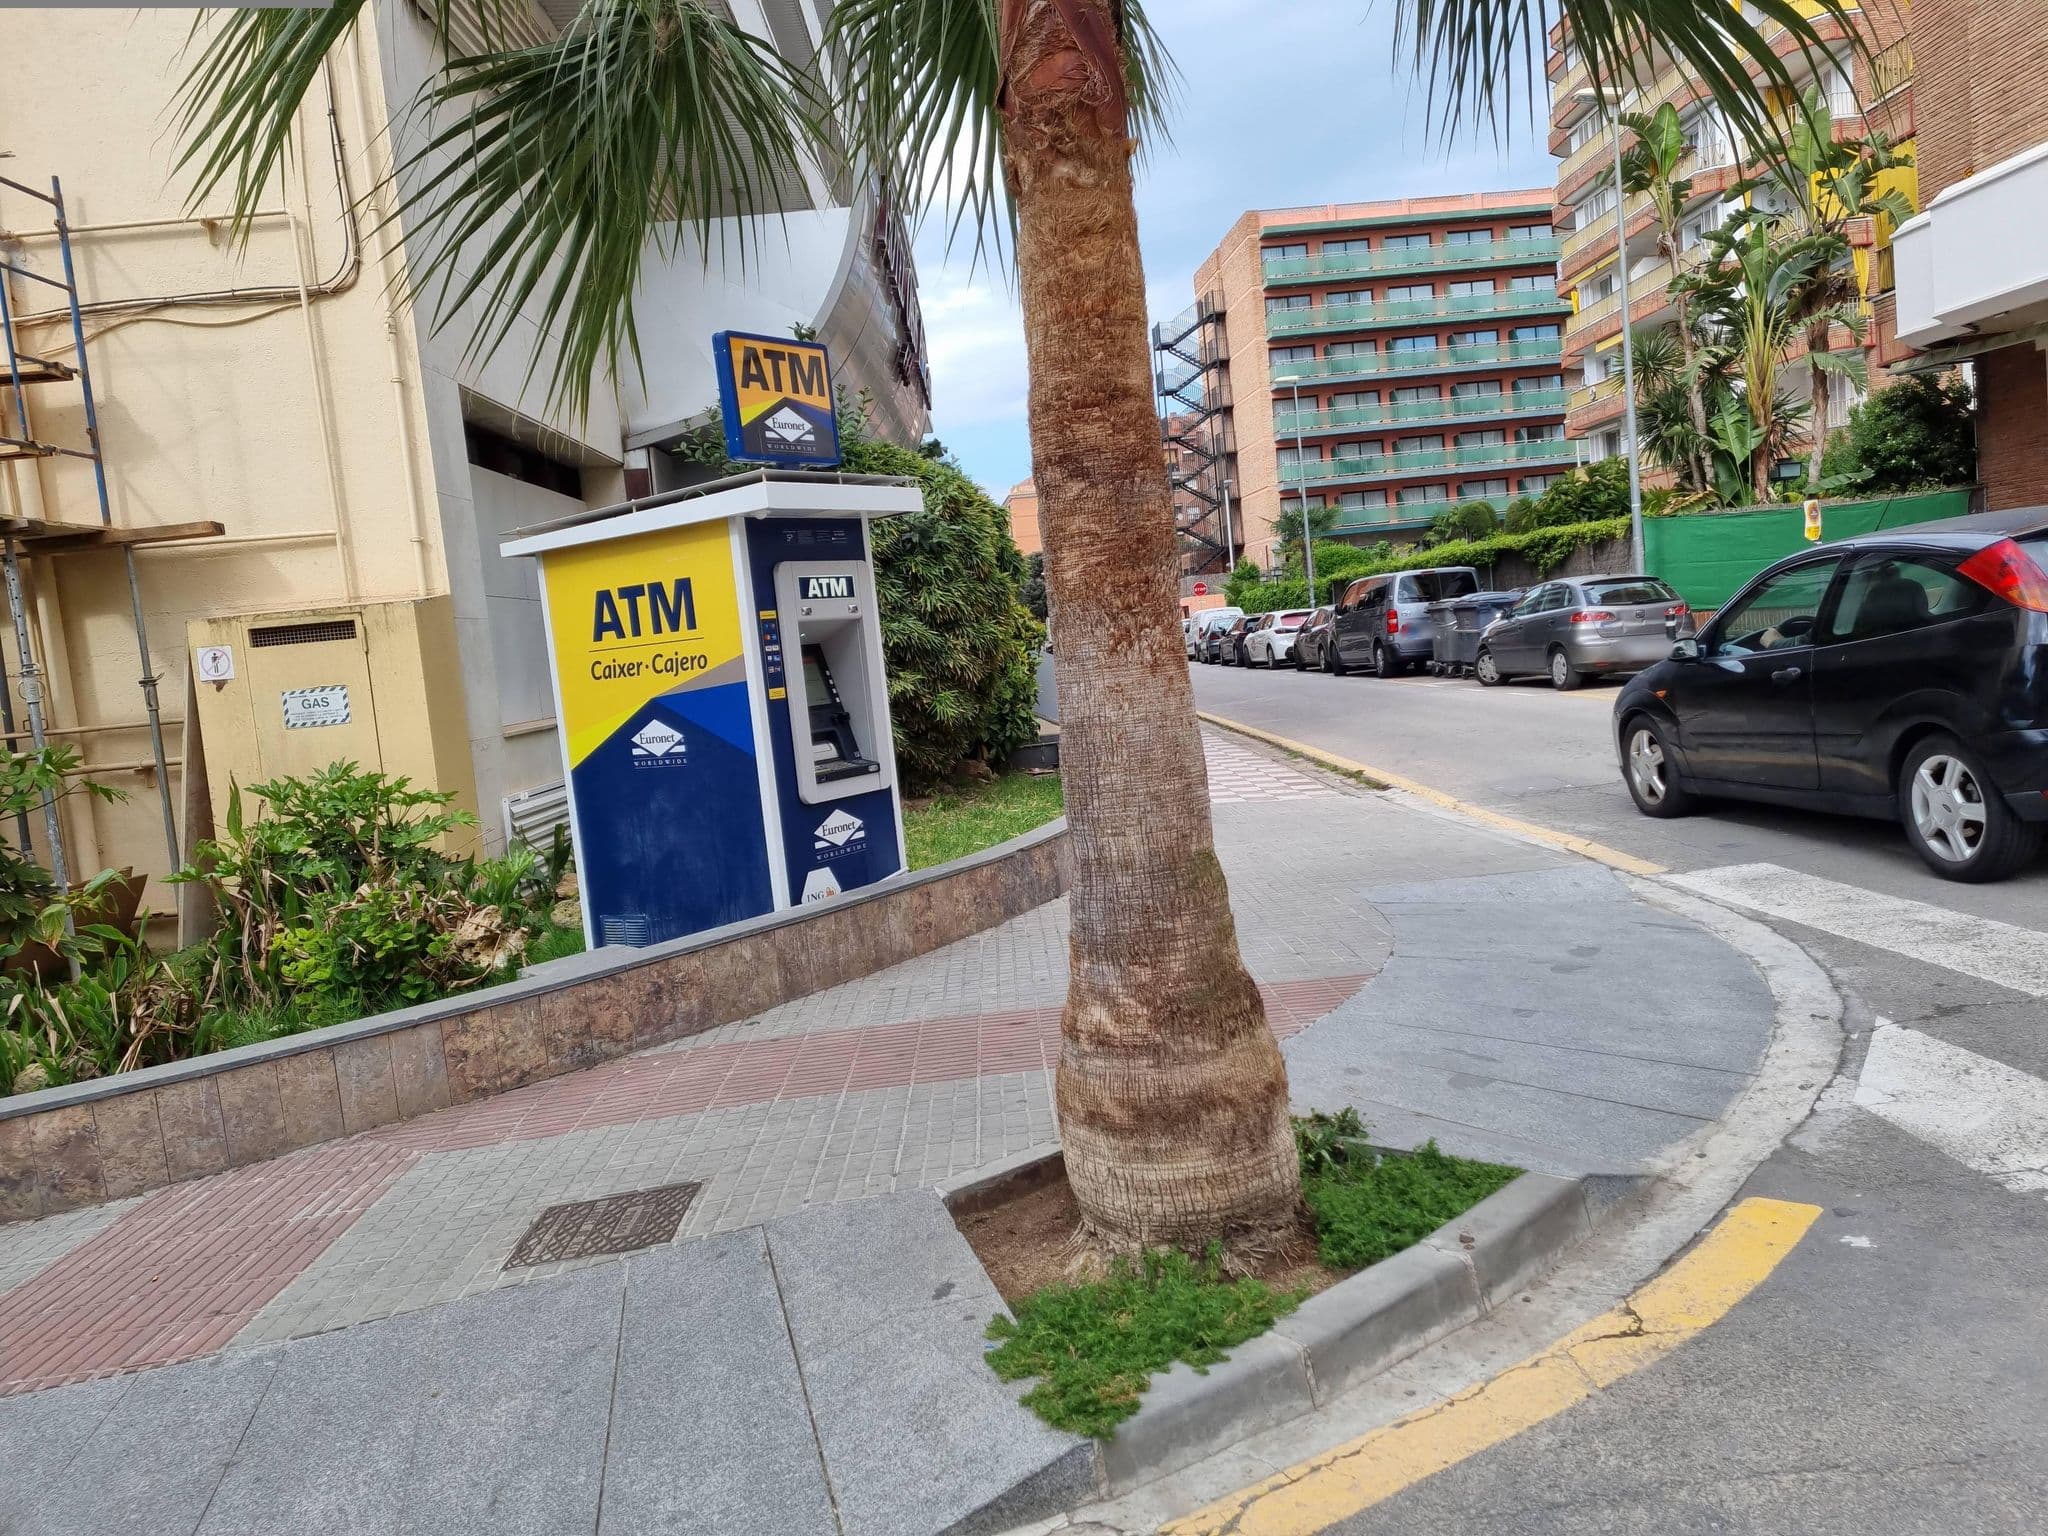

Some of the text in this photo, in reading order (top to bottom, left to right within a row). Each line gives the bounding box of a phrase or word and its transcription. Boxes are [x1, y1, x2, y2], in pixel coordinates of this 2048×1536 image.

[741, 345, 825, 397] ATM
[771, 417, 806, 432] Euronet
[766, 443, 817, 452] WORLDWIDE
[807, 577, 848, 598] ATM
[593, 577, 697, 642] ATM
[591, 652, 708, 680] Caixer Cajero
[301, 696, 330, 710] GAS
[638, 732, 676, 746] Euronet
[633, 758, 687, 767] WORLDWIDE
[821, 820, 856, 837] Euronet
[816, 843, 867, 861] WORLDWIDE
[806, 890, 825, 903] ING
